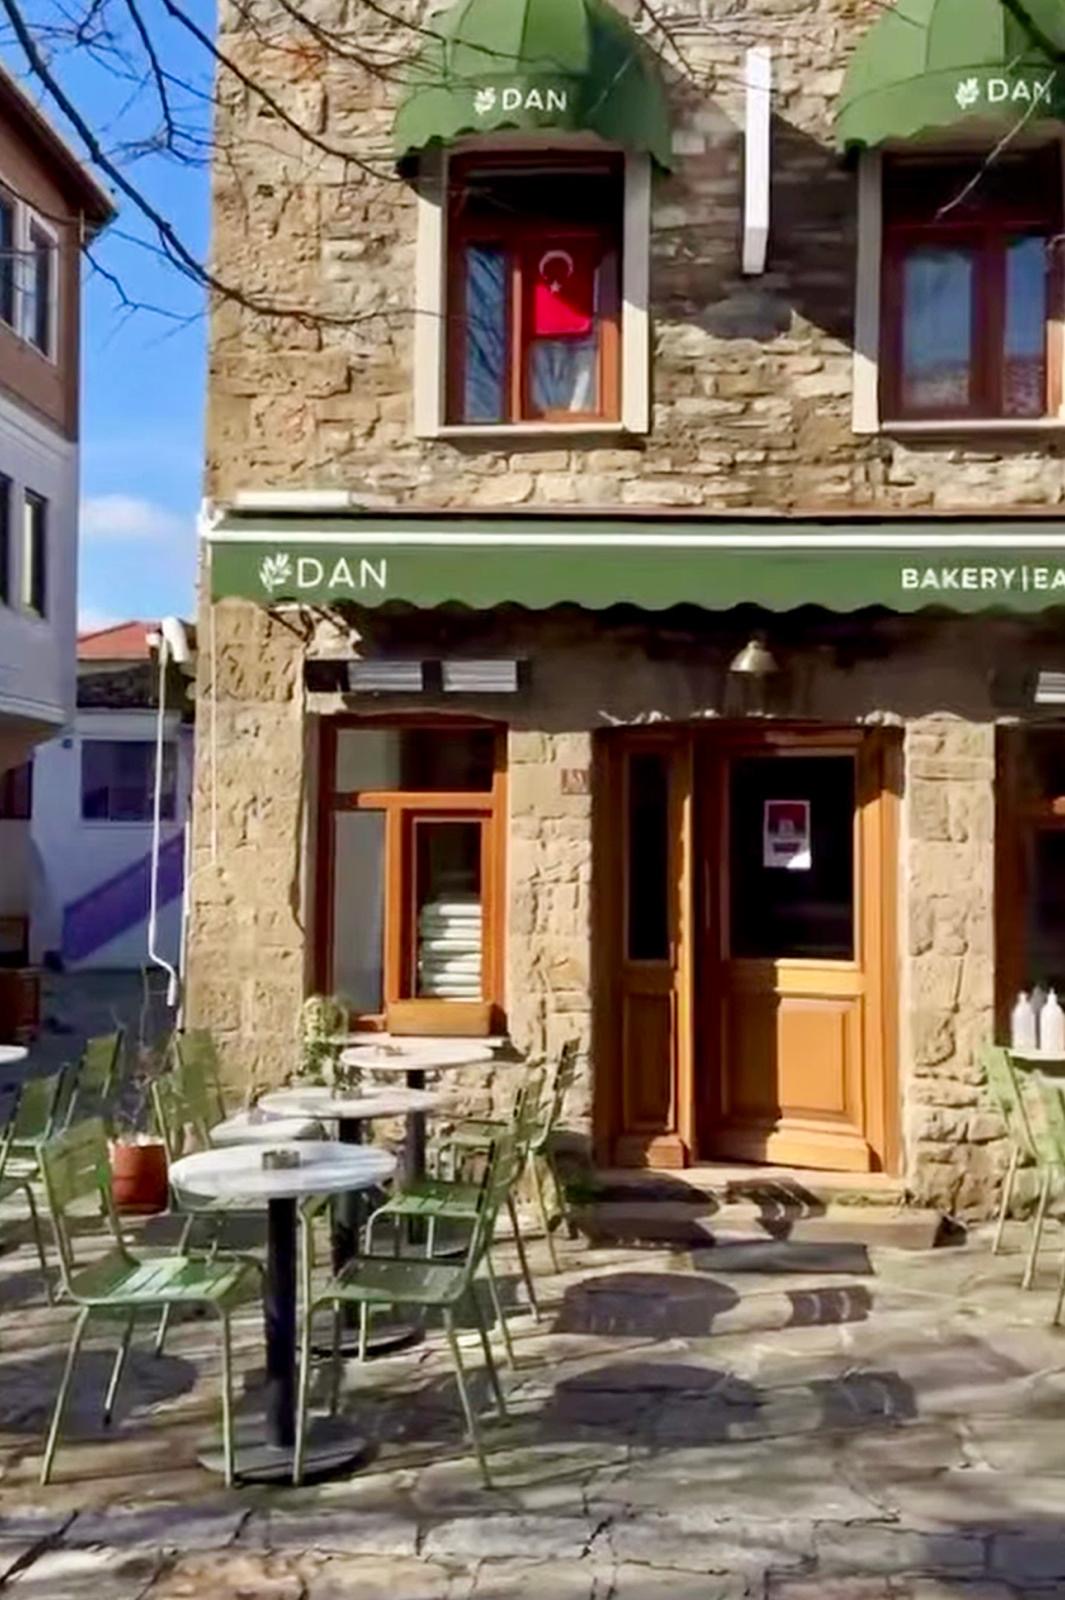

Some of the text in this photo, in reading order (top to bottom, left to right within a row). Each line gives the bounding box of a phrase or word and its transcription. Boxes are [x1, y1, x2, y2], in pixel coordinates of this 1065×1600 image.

[502, 88, 567, 112] DAN
[988, 79, 1052, 104] DAN
[298, 557, 387, 589] DAN
